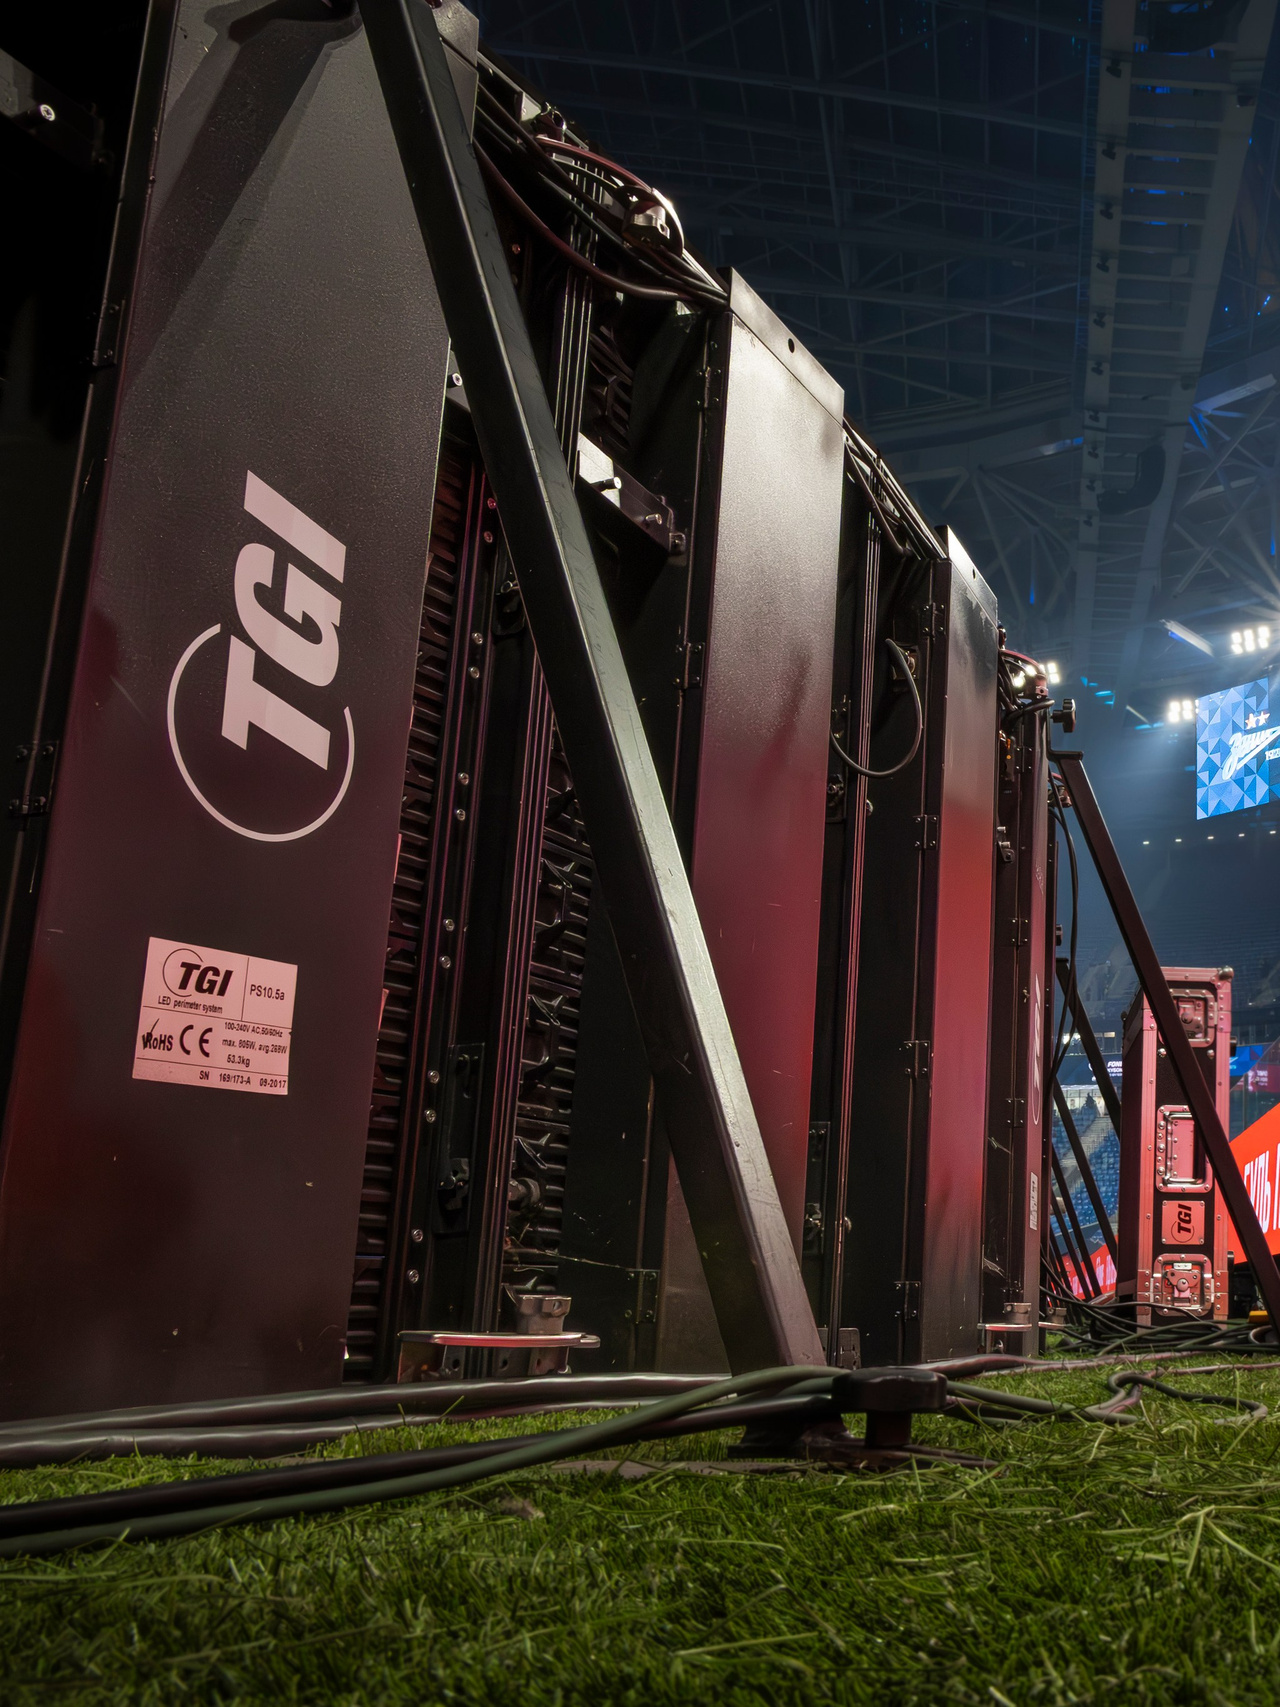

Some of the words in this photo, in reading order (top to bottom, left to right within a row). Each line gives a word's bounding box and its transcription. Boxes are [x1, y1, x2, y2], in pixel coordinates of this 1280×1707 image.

[222, 469, 346, 770] TGI
[178, 961, 234, 997] TGI
[250, 984, 285, 1000] PS10.5a
[158, 995, 171, 1005] LED
[173, 999, 202, 1010] perimeter
[202, 1003, 223, 1013] system
[224, 1021, 250, 1033] 100-240V
[222, 1039, 237, 1047] max.
[227, 1054, 250, 1067] 53.3kg
[199, 1070, 210, 1081] SN
[219, 1073, 250, 1085] 169/173-A
[259, 1075, 287, 1089] 09-2017
[1177, 1203, 1192, 1233] TGI
